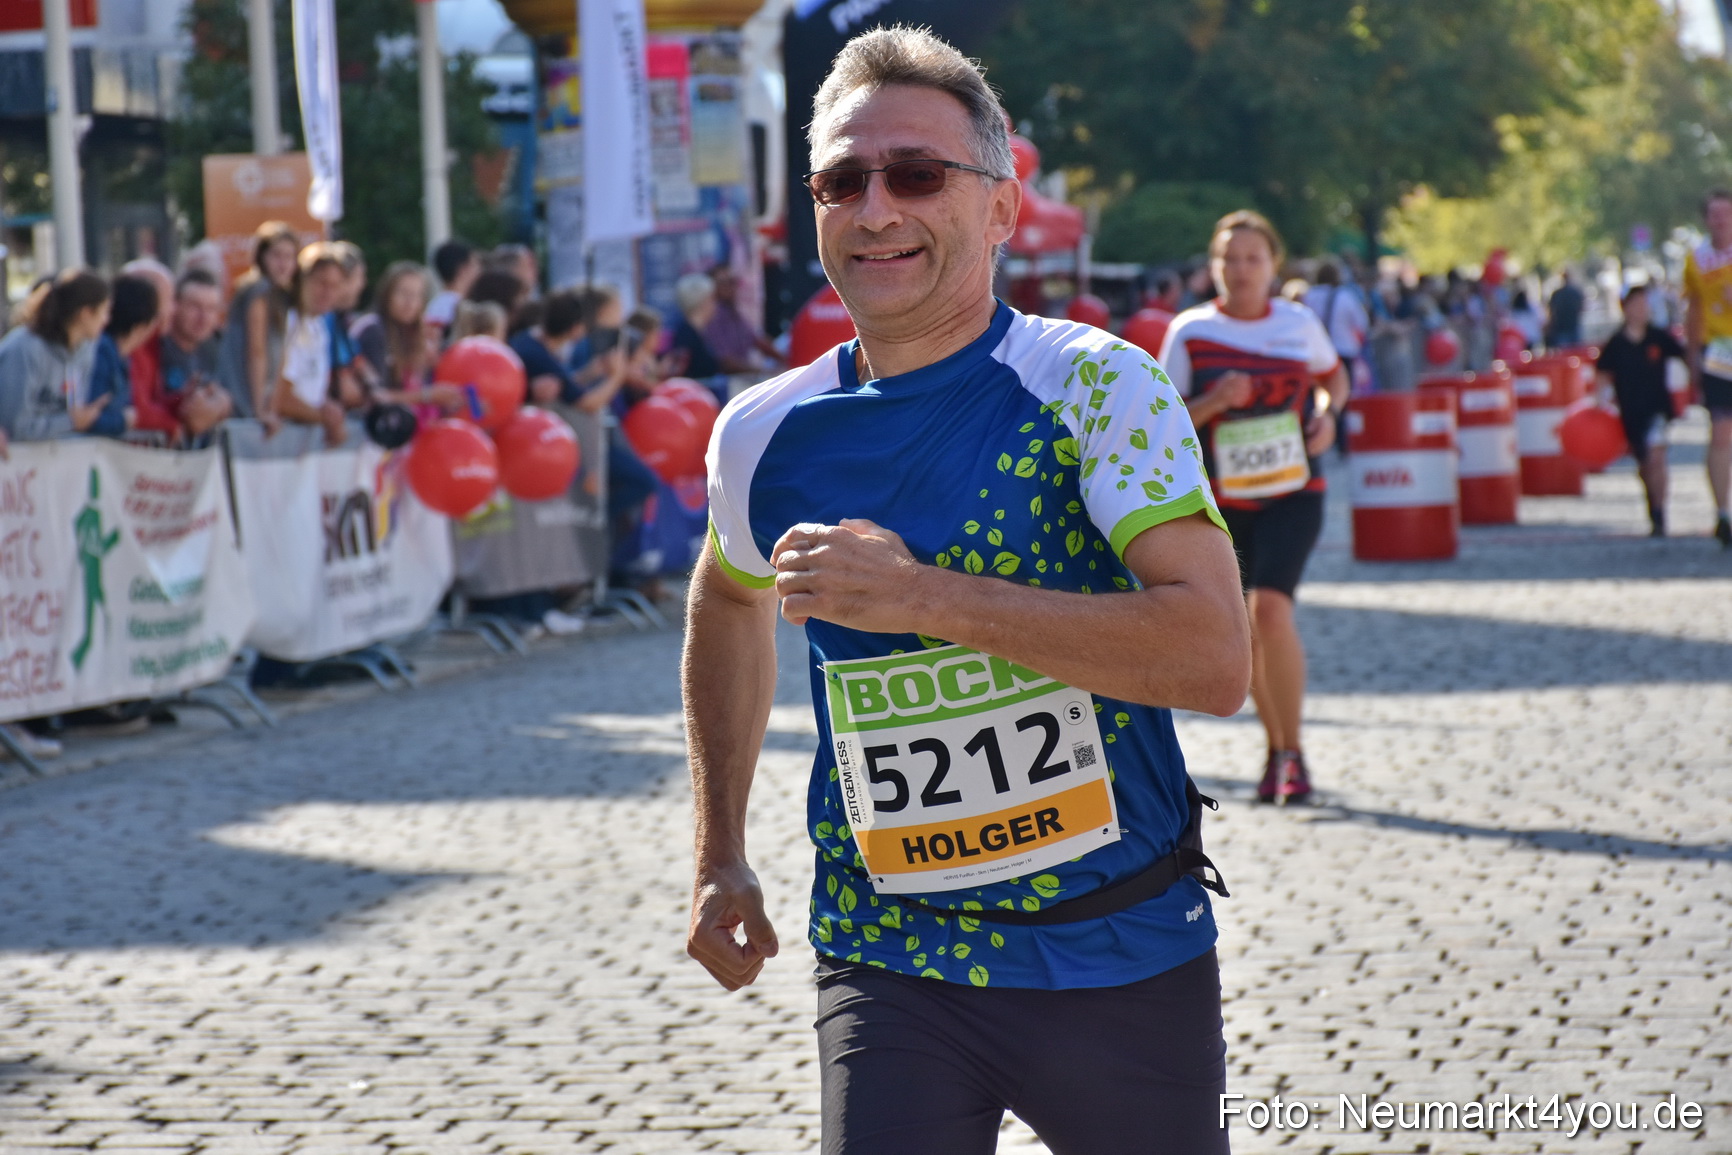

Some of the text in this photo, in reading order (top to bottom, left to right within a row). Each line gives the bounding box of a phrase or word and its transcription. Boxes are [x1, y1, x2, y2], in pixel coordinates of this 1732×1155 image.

[864, 711, 1071, 813] 5212
[901, 806, 1065, 865] HOLGER
[1011, 860, 1025, 868] Holger
